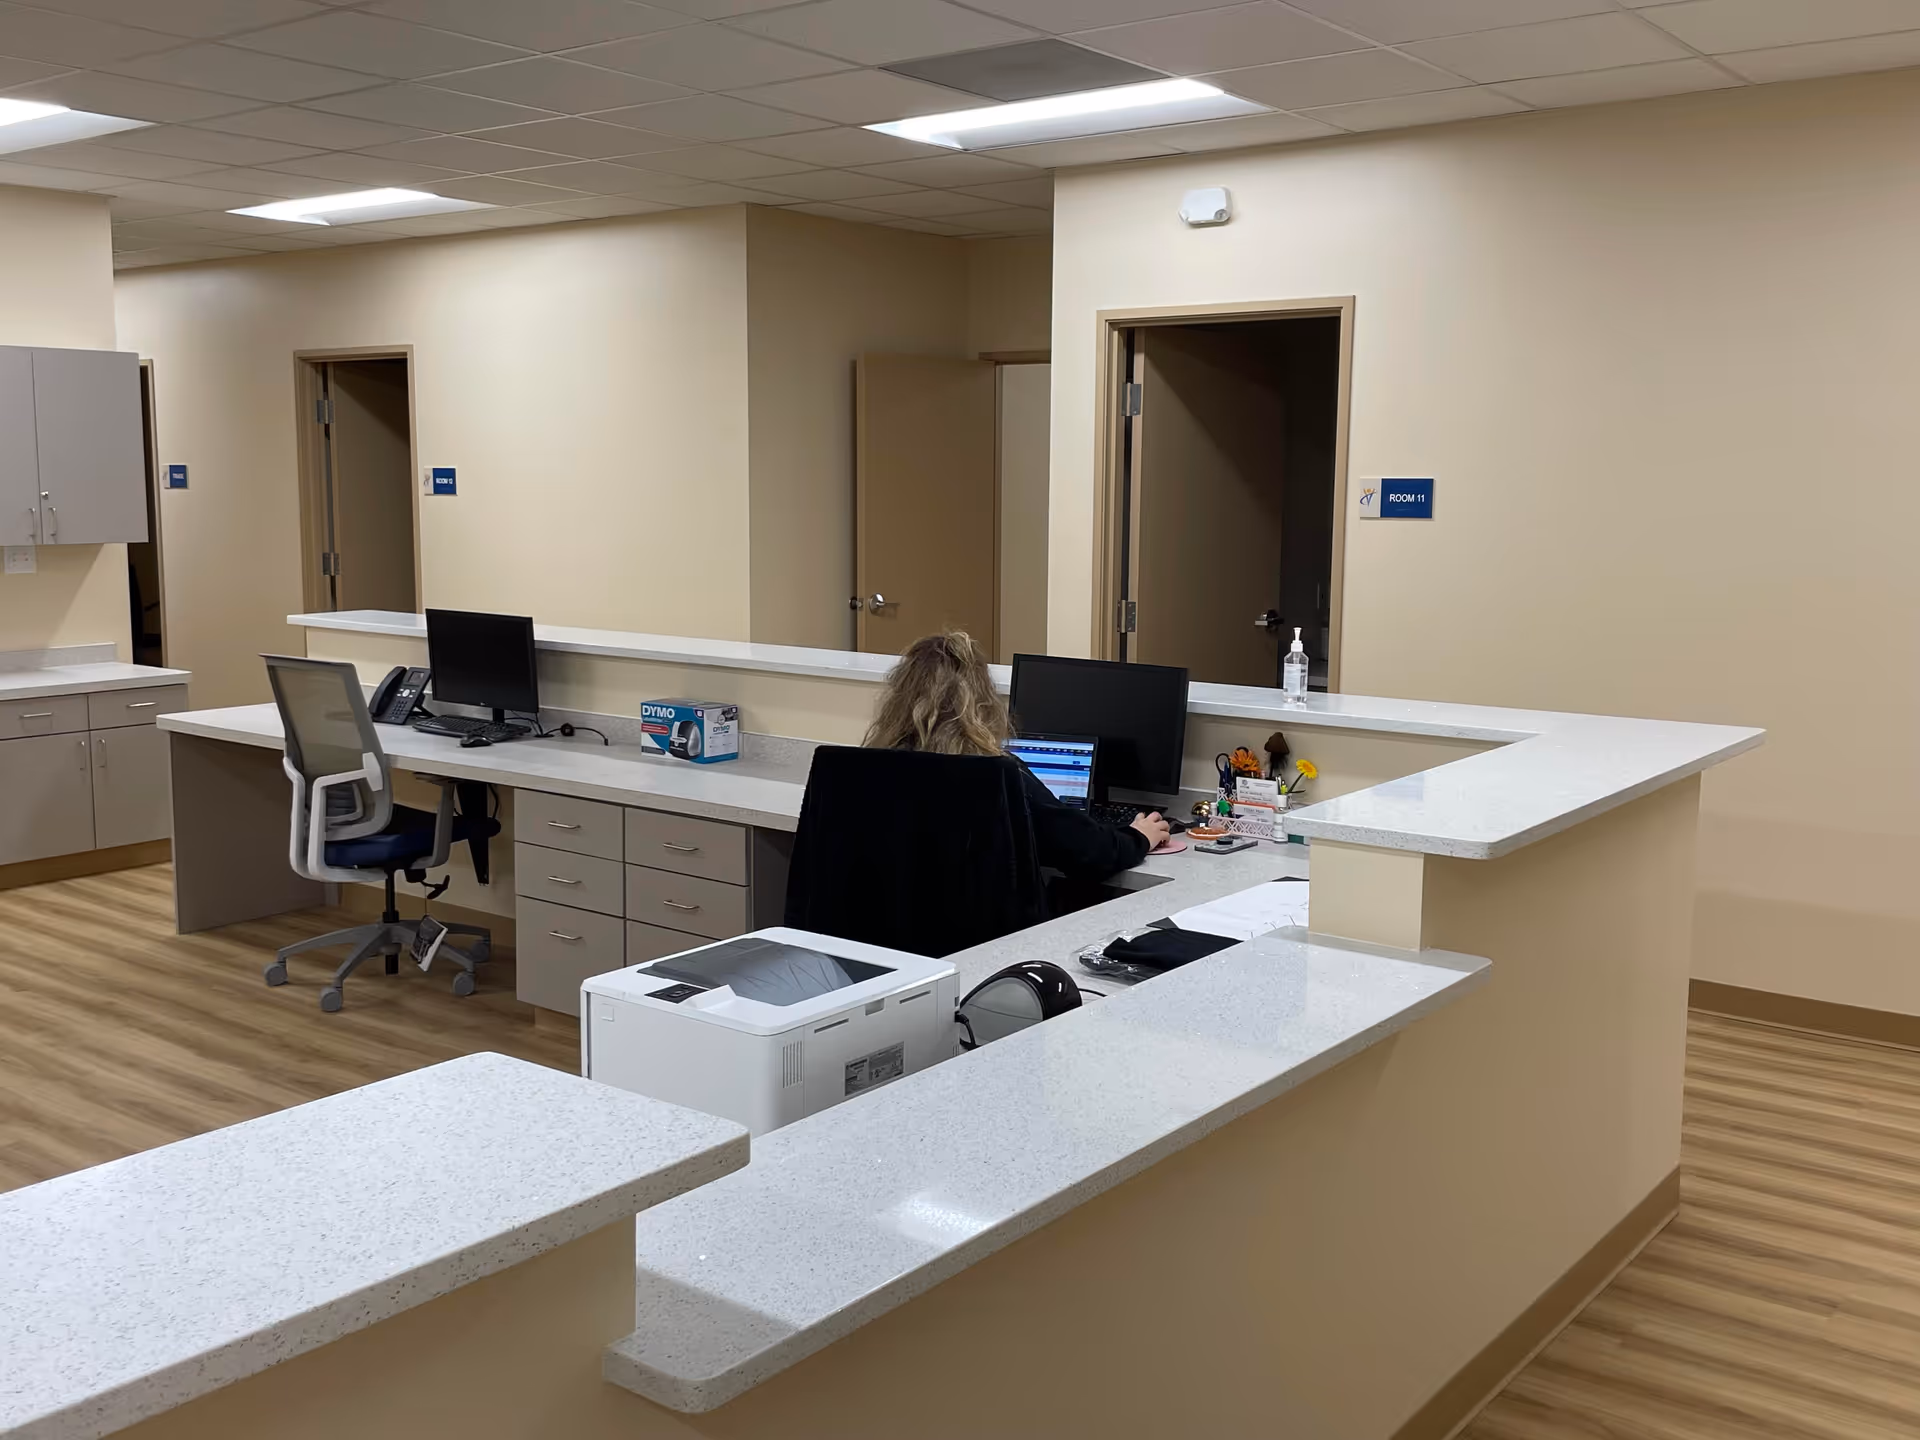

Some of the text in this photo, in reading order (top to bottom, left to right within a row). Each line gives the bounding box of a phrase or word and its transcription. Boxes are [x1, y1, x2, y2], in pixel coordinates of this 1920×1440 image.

[1389, 493, 1425, 503] ROOM 11
[642, 705, 675, 718] DYMO
